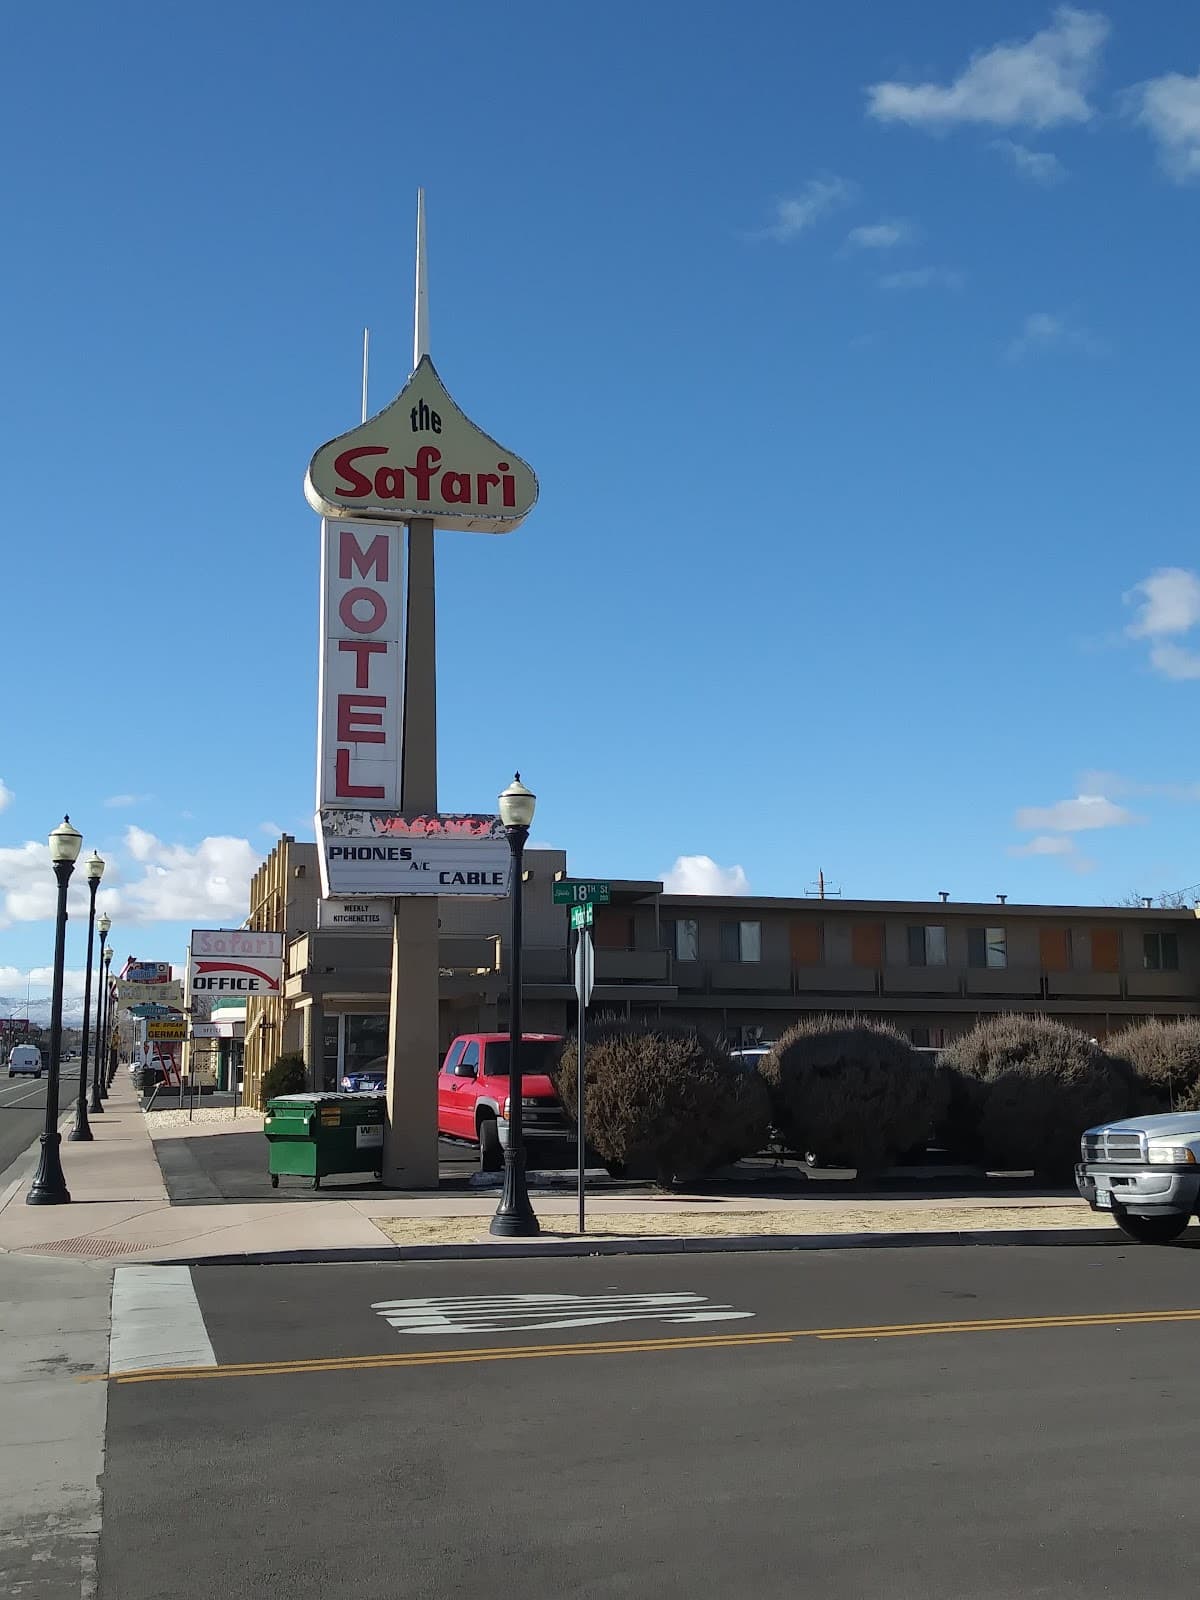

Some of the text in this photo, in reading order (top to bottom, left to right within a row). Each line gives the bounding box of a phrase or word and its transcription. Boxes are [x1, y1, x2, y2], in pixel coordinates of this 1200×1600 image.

[409, 397, 442, 435] the
[333, 445, 516, 508] Safari
[335, 530, 390, 799] MOTEL
[372, 816, 494, 837] VACANCY
[328, 846, 412, 861] PHONES
[409, 861, 430, 871] A/C
[439, 871, 504, 886] CABLE
[343, 904, 369, 912] WEEKLY
[333, 914, 380, 923] KITCHENETTES
[200, 933, 274, 954] Safari
[192, 977, 260, 991] OFFICE
[148, 1031, 186, 1039] GERMAN
